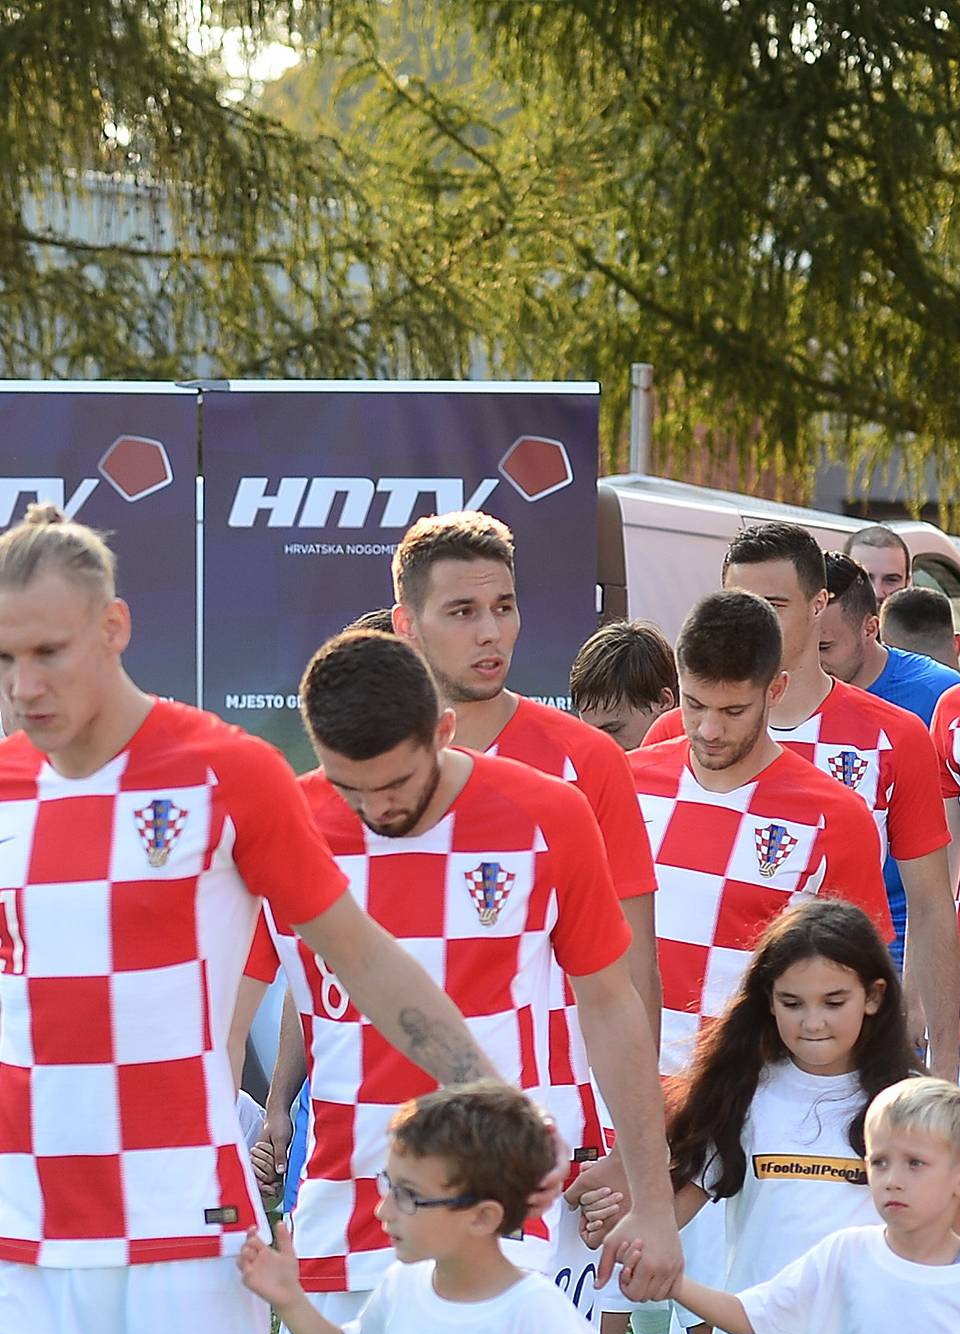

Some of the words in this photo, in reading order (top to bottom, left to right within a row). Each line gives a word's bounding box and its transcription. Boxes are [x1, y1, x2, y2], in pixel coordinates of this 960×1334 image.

[228, 477, 500, 527] HNTV
[284, 543, 345, 555] HRVATSKA
[225, 694, 285, 709] MJESTO
[0, 889, 24, 976] 1
